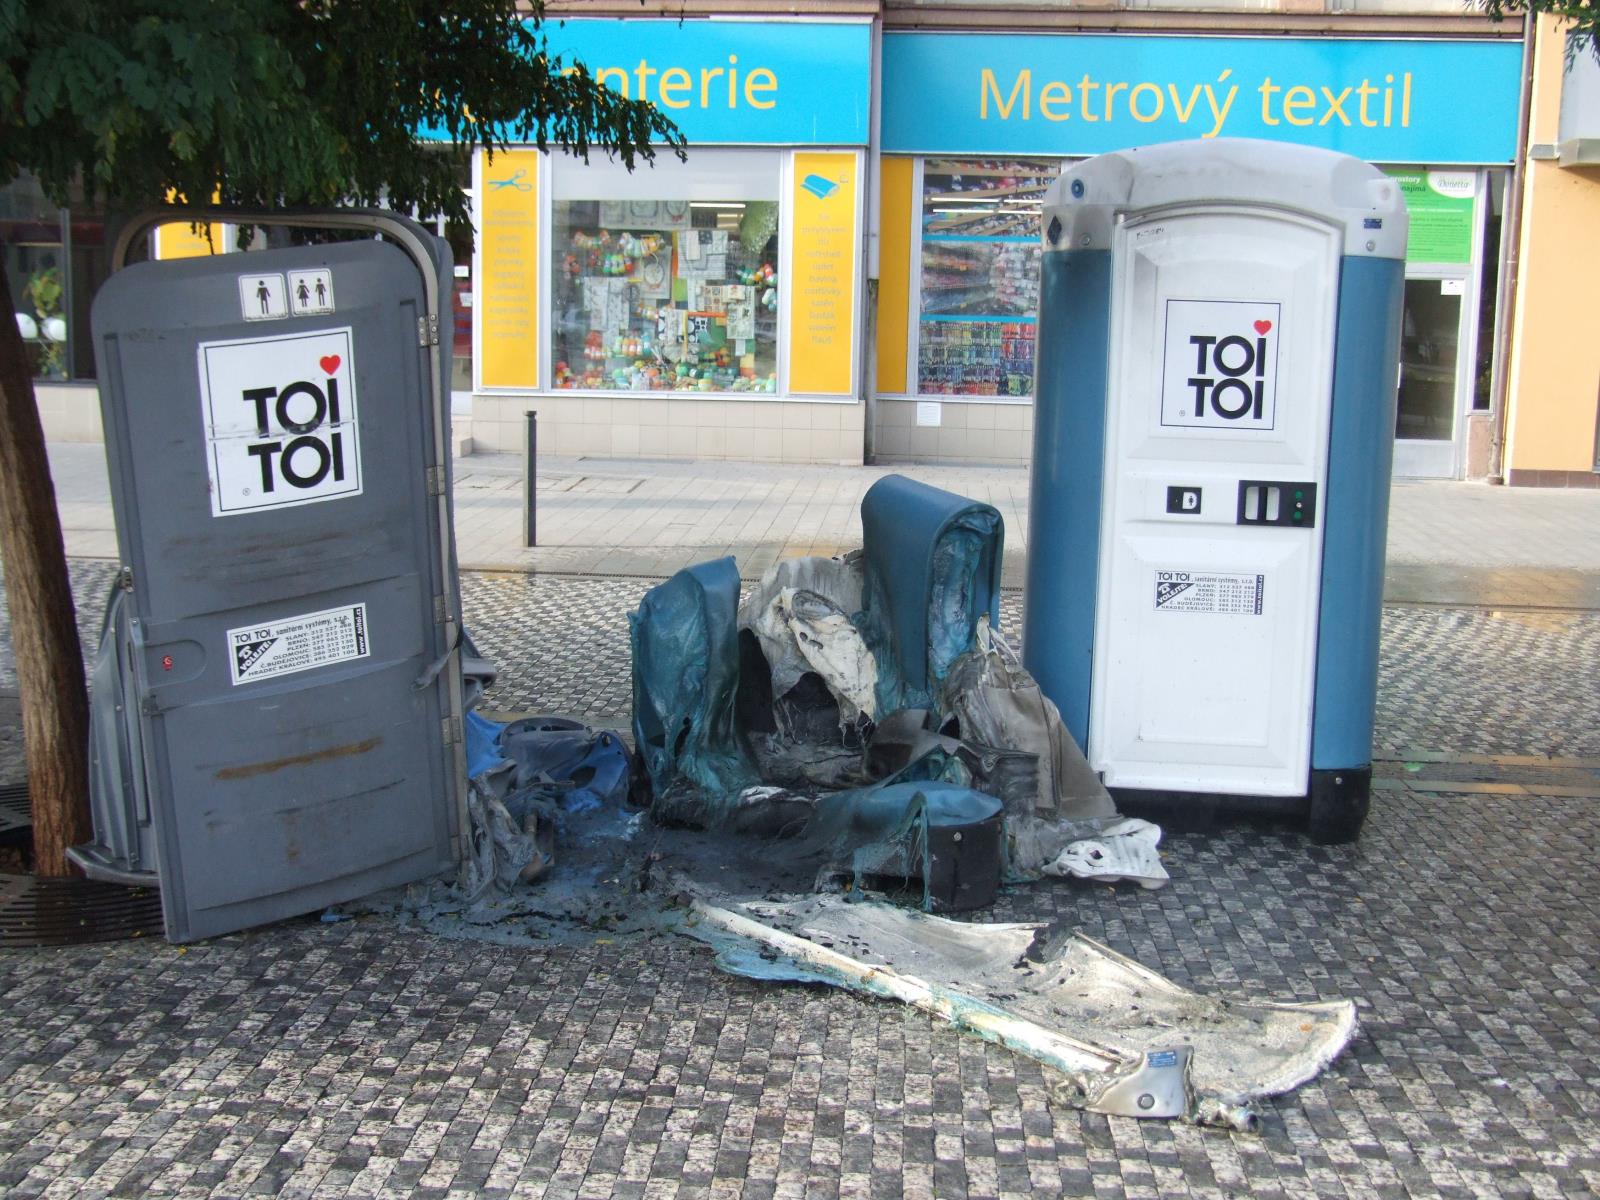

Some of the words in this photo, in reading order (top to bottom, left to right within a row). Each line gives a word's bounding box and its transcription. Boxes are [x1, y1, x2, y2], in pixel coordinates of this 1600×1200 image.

[979, 67, 1237, 139] Metrový
[1259, 71, 1413, 128] textil
[1390, 175, 1421, 184] rostory
[1190, 335, 1266, 377] TOI
[242, 378, 341, 439] TOI
[1187, 378, 1264, 420] TOI
[247, 432, 344, 494] TOI
[1157, 572, 1172, 580] TOI
[234, 634, 251, 644] TOI
